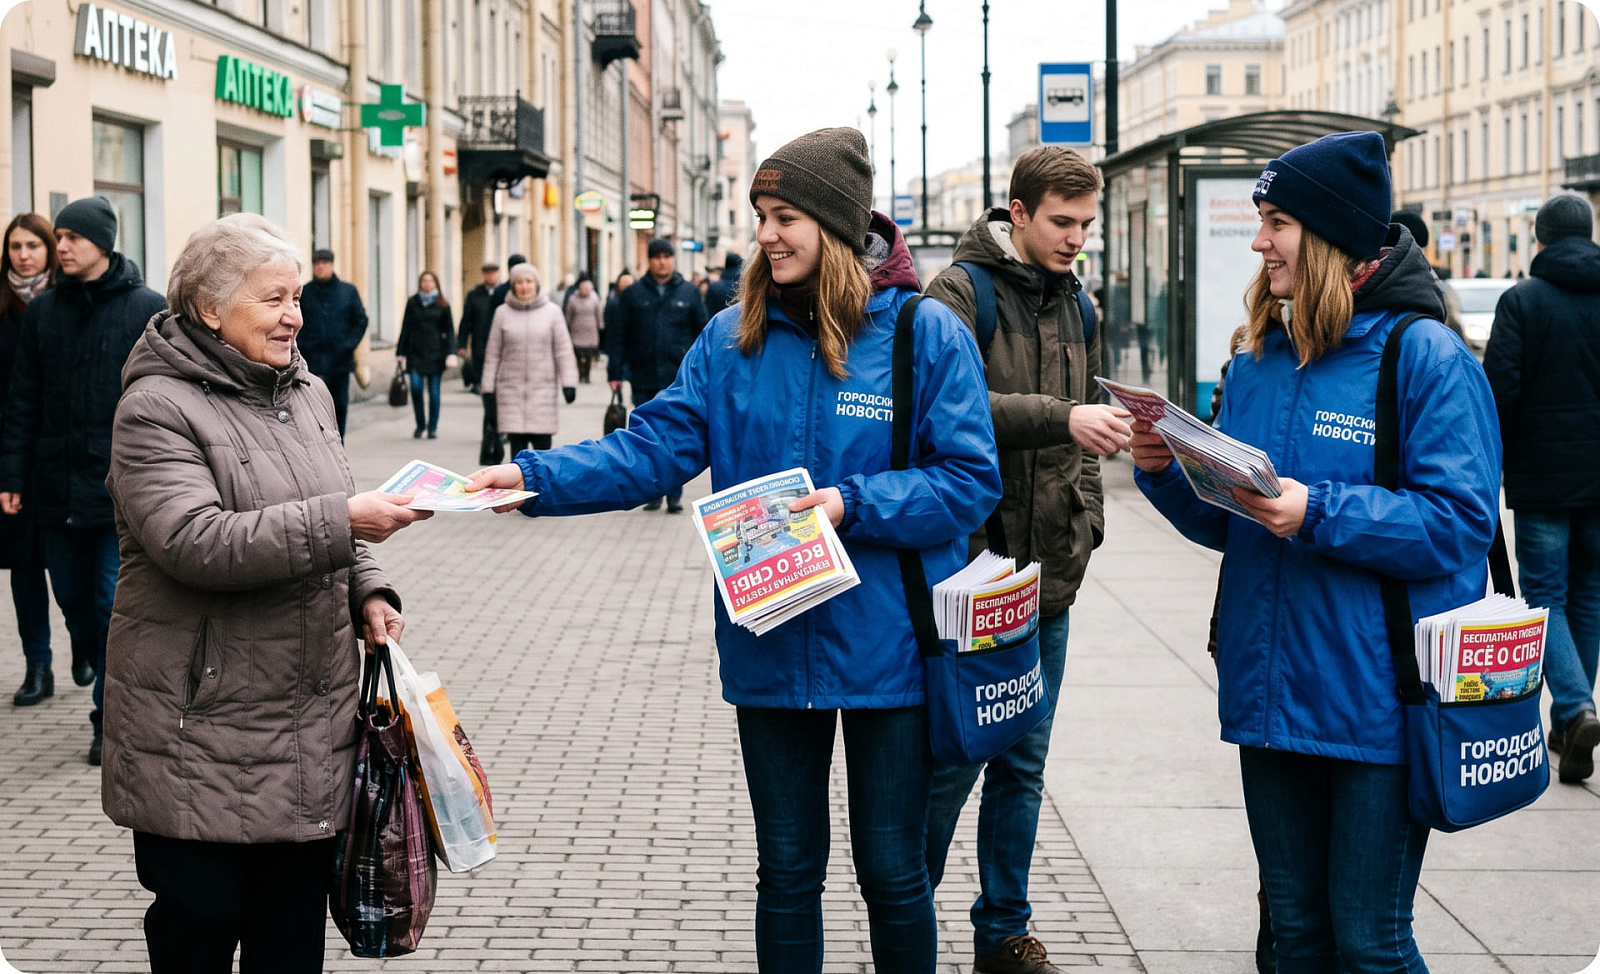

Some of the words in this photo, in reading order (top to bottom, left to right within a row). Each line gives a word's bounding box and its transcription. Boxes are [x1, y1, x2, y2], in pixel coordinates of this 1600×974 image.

[83, 3, 178, 80] АПТЕКА
[223, 55, 293, 118] АПТЕКА
[837, 391, 893, 408] ГОРОДСКИ
[1315, 410, 1376, 430] ГОРОДСКИ
[776, 558, 790, 573] О
[791, 543, 825, 569] ВСЁ
[975, 607, 1003, 631] ВСЁ
[1005, 608, 1015, 624] О
[1461, 644, 1494, 667] ВСЁ
[1497, 647, 1509, 665] О
[1512, 640, 1540, 663] СПБ!
[1461, 742, 1543, 787] НОВОСТИ
